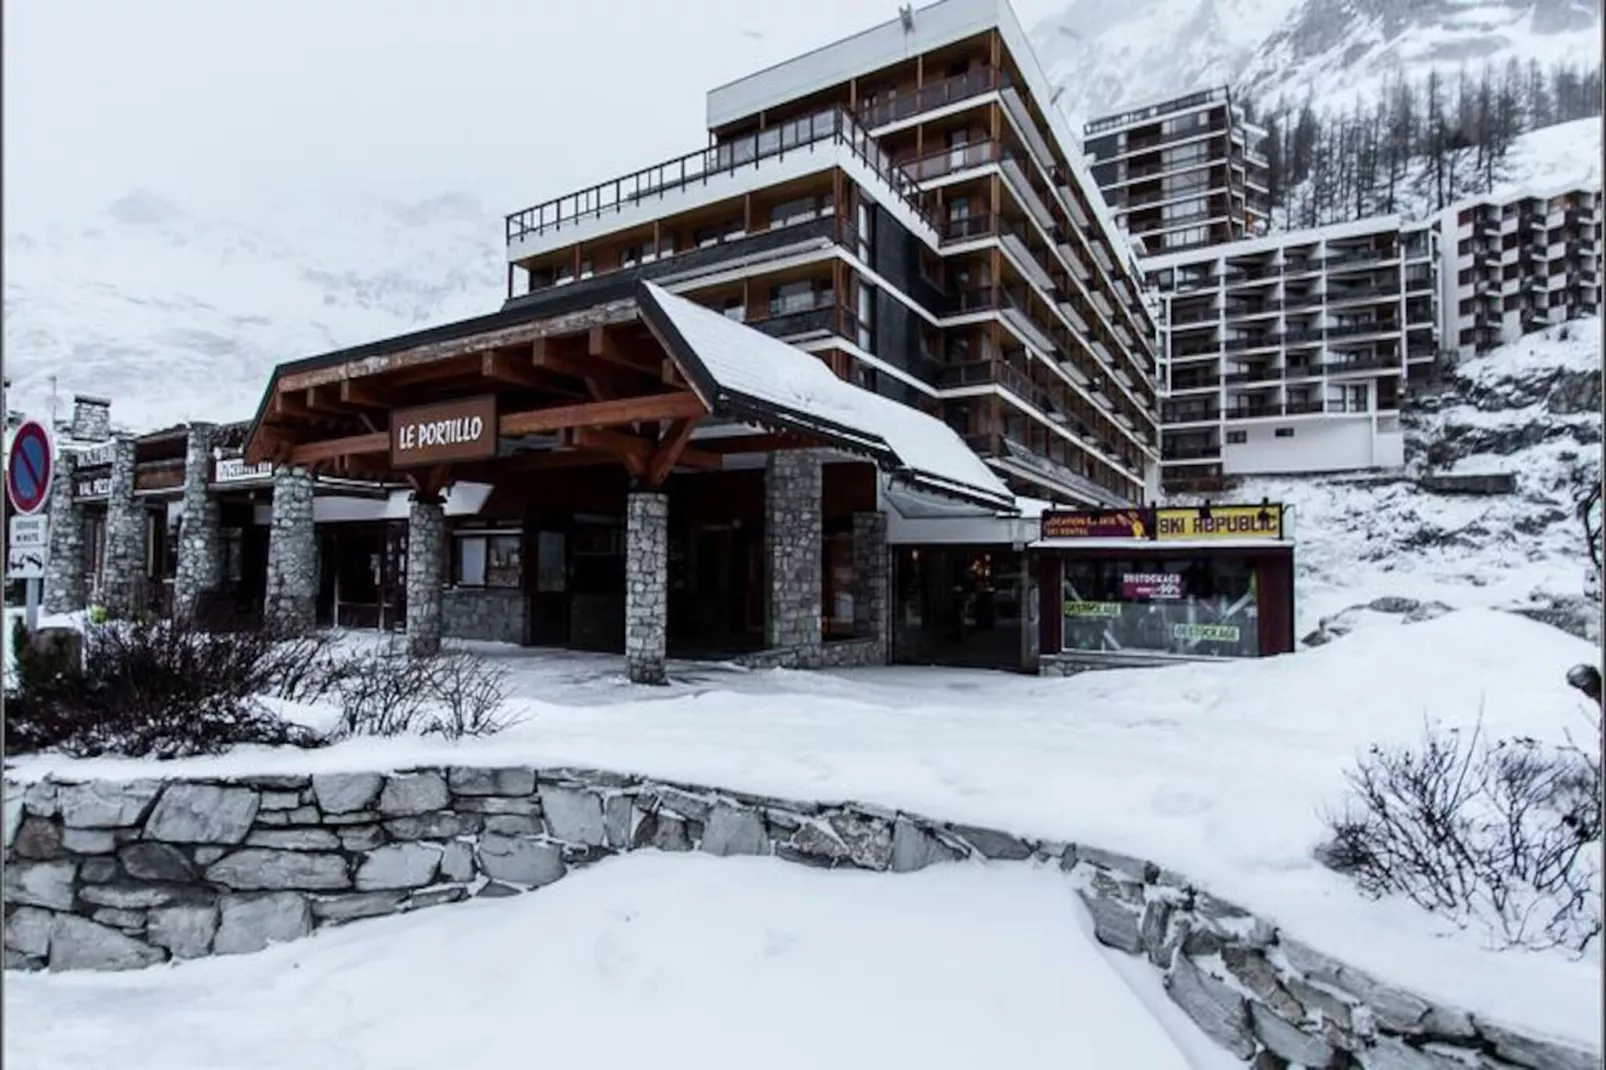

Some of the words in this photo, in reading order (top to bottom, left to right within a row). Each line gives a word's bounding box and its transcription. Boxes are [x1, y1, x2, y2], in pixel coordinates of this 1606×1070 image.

[399, 424, 415, 449] LE
[418, 416, 483, 448] PORTILLO
[1160, 517, 1185, 534] SKI
[1193, 514, 1277, 533] REPUBLIC
